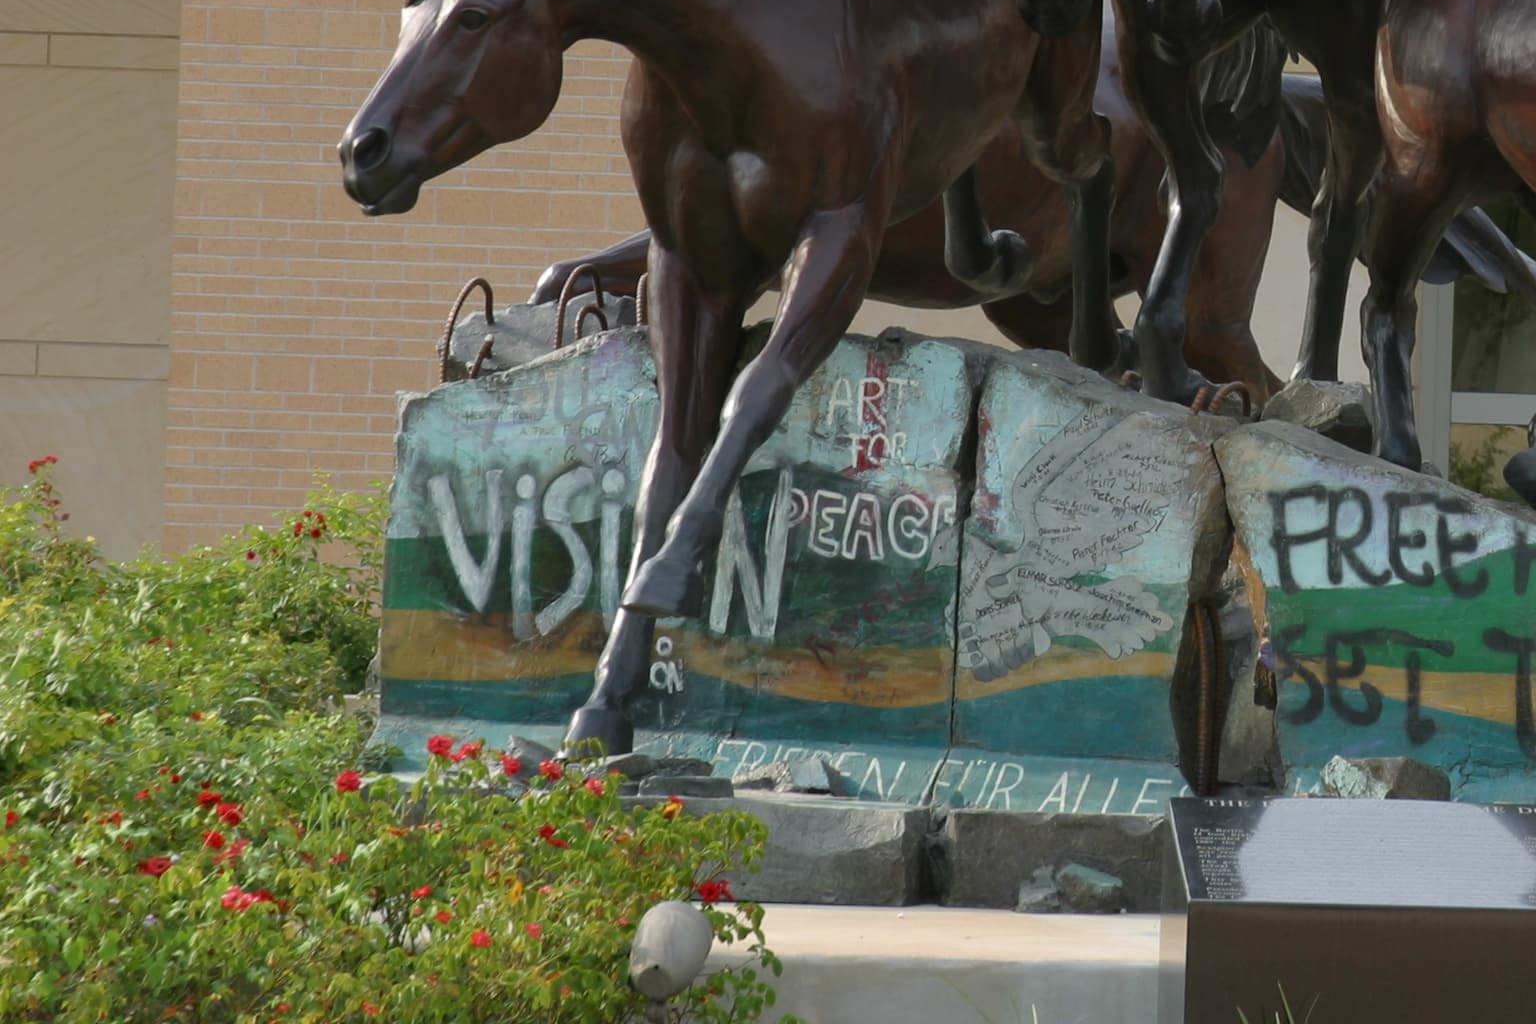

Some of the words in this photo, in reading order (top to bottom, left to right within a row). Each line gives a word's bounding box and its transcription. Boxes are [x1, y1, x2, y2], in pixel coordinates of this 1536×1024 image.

[828, 377, 919, 431] ART
[848, 432, 908, 469] FOR
[1268, 484, 1490, 598] FREE
[712, 739, 907, 801] FREN
[1036, 771, 1196, 816] ALLE
[1203, 799, 1250, 808] THE
